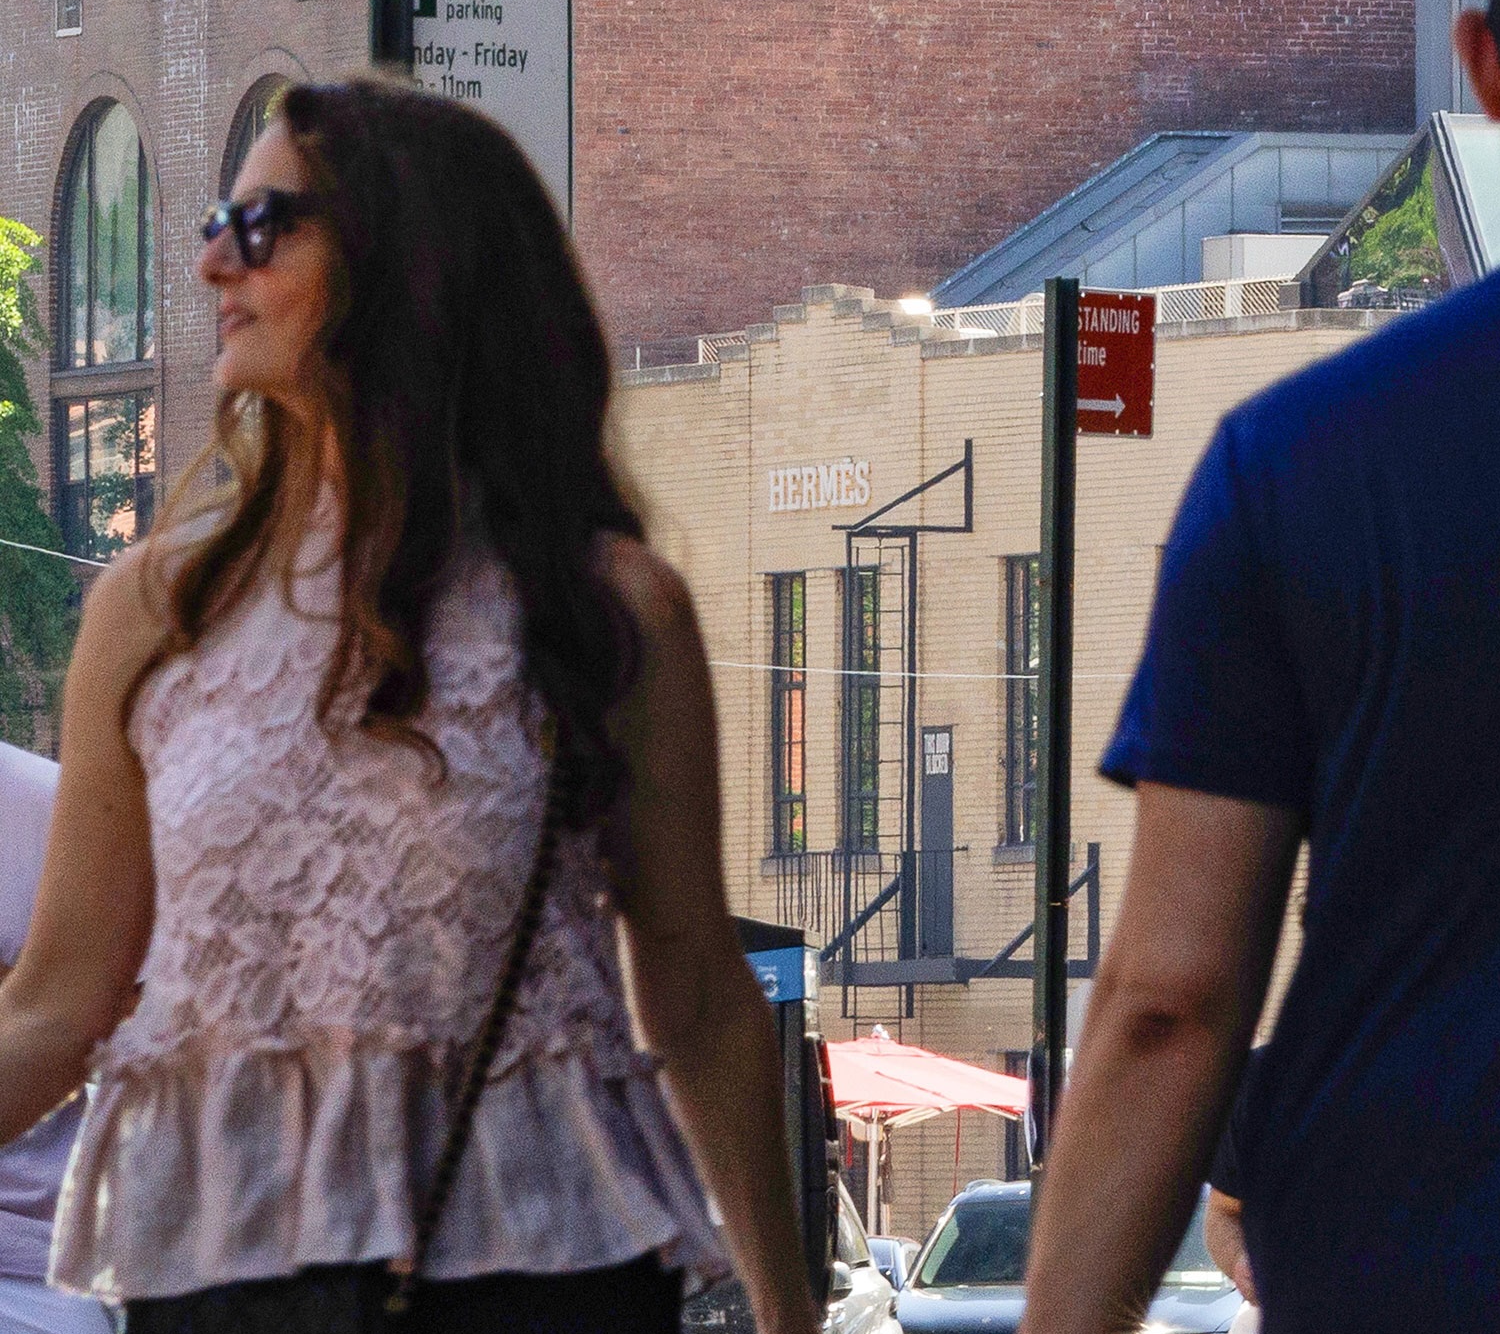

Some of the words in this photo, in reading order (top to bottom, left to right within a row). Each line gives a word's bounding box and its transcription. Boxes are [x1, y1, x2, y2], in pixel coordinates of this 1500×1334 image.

[446, 0, 503, 25] parking
[413, 41, 455, 71] nday
[474, 42, 528, 73] Friday
[440, 74, 482, 100] 11pm
[1077, 340, 1107, 367] time
